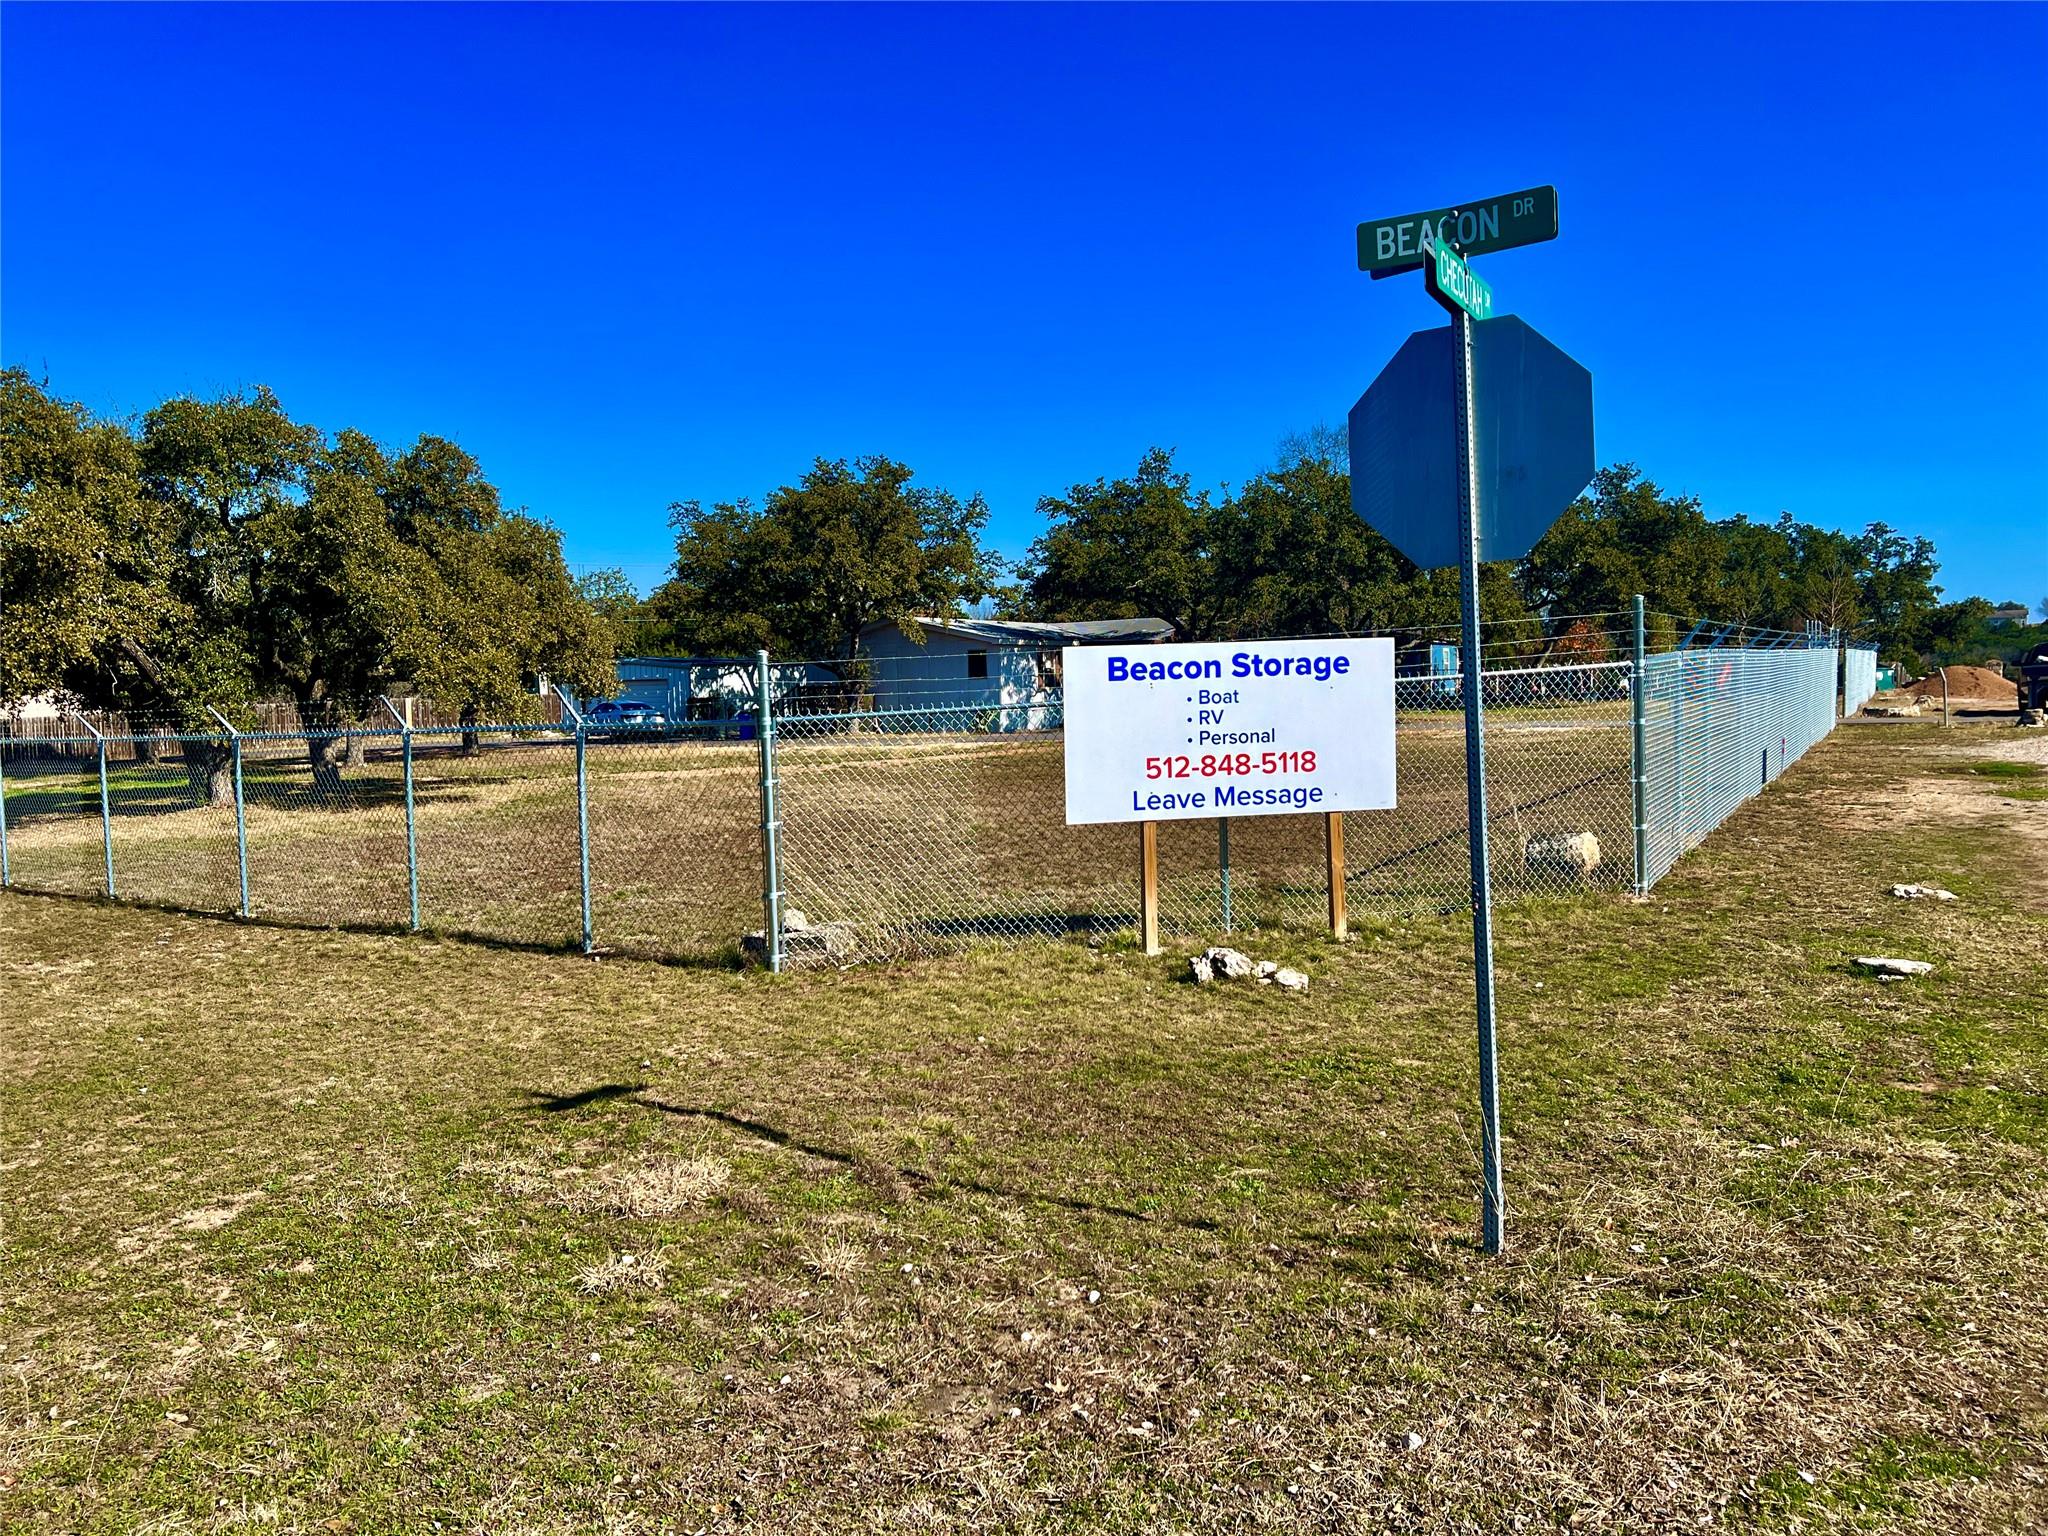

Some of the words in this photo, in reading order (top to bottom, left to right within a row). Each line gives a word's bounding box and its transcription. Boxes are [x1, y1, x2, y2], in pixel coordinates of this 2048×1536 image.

[1376, 204, 1500, 261] BEACON
[1513, 196, 1535, 218] DR
[1107, 656, 1222, 682] Beacon
[1231, 653, 1350, 682] Storage
[1198, 689, 1240, 705] Boat
[1199, 709, 1225, 726] RV
[1199, 727, 1276, 746] Personal
[1146, 750, 1317, 780] 512-848-5118
[1133, 790, 1206, 812] Leave
[1214, 785, 1324, 809] Message
